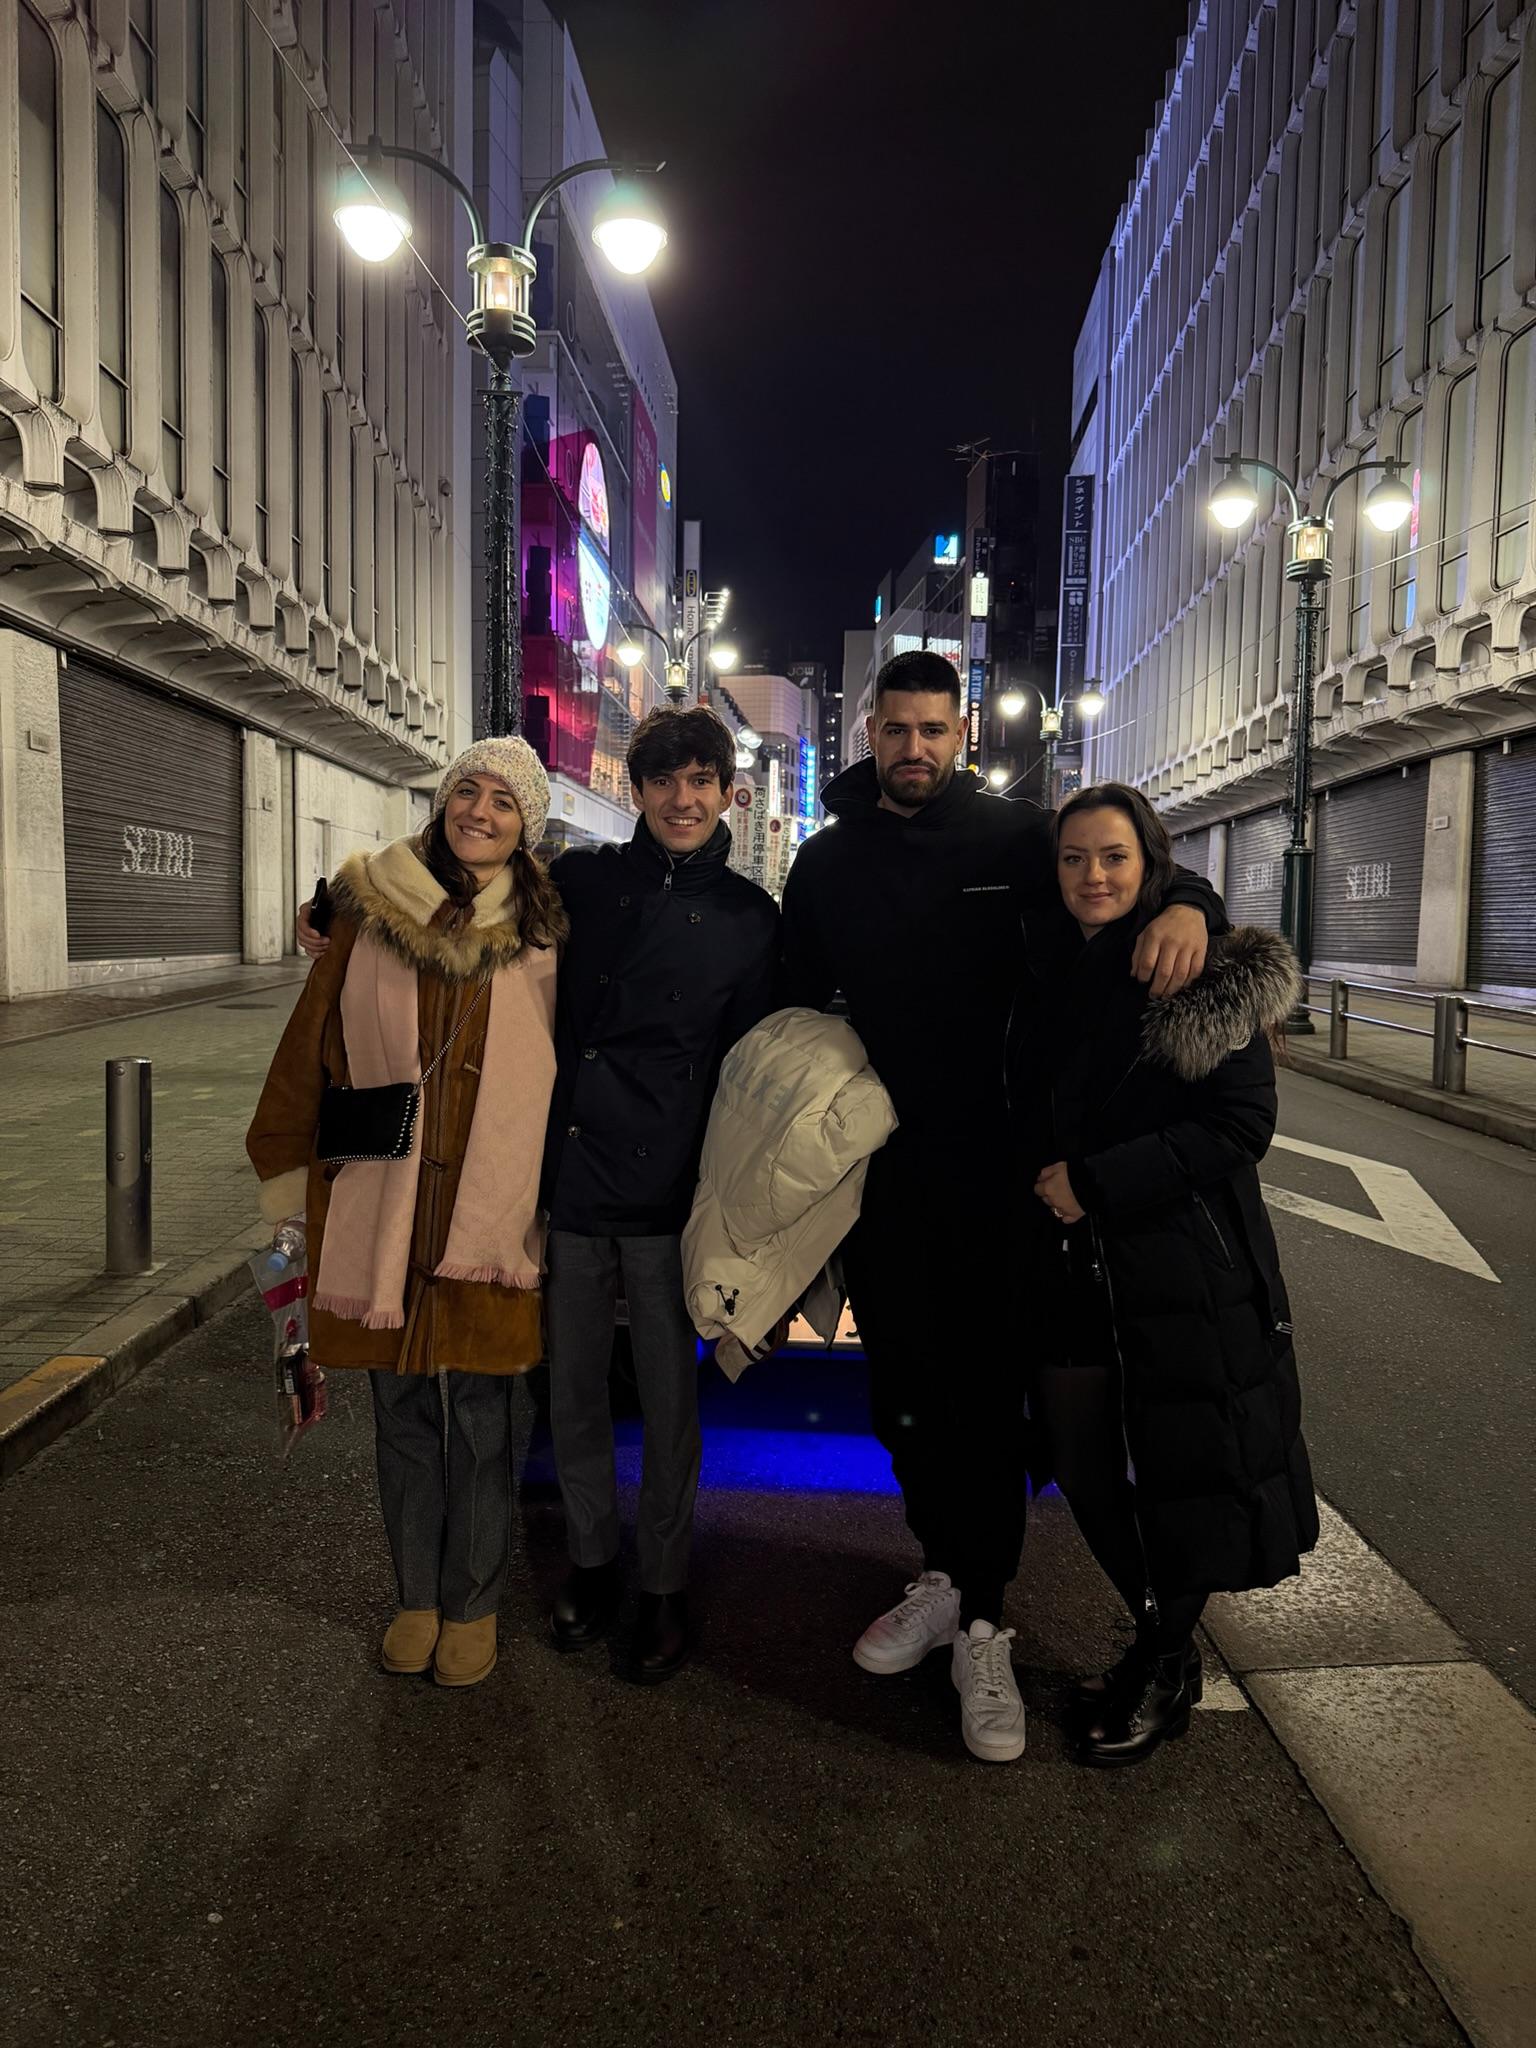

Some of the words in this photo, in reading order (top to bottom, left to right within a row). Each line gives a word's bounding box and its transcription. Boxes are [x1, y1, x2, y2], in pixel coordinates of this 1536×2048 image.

[1074, 479, 1086, 528] シネクイント
[686, 606, 696, 638] Home
[122, 825, 194, 878] SEIBU
